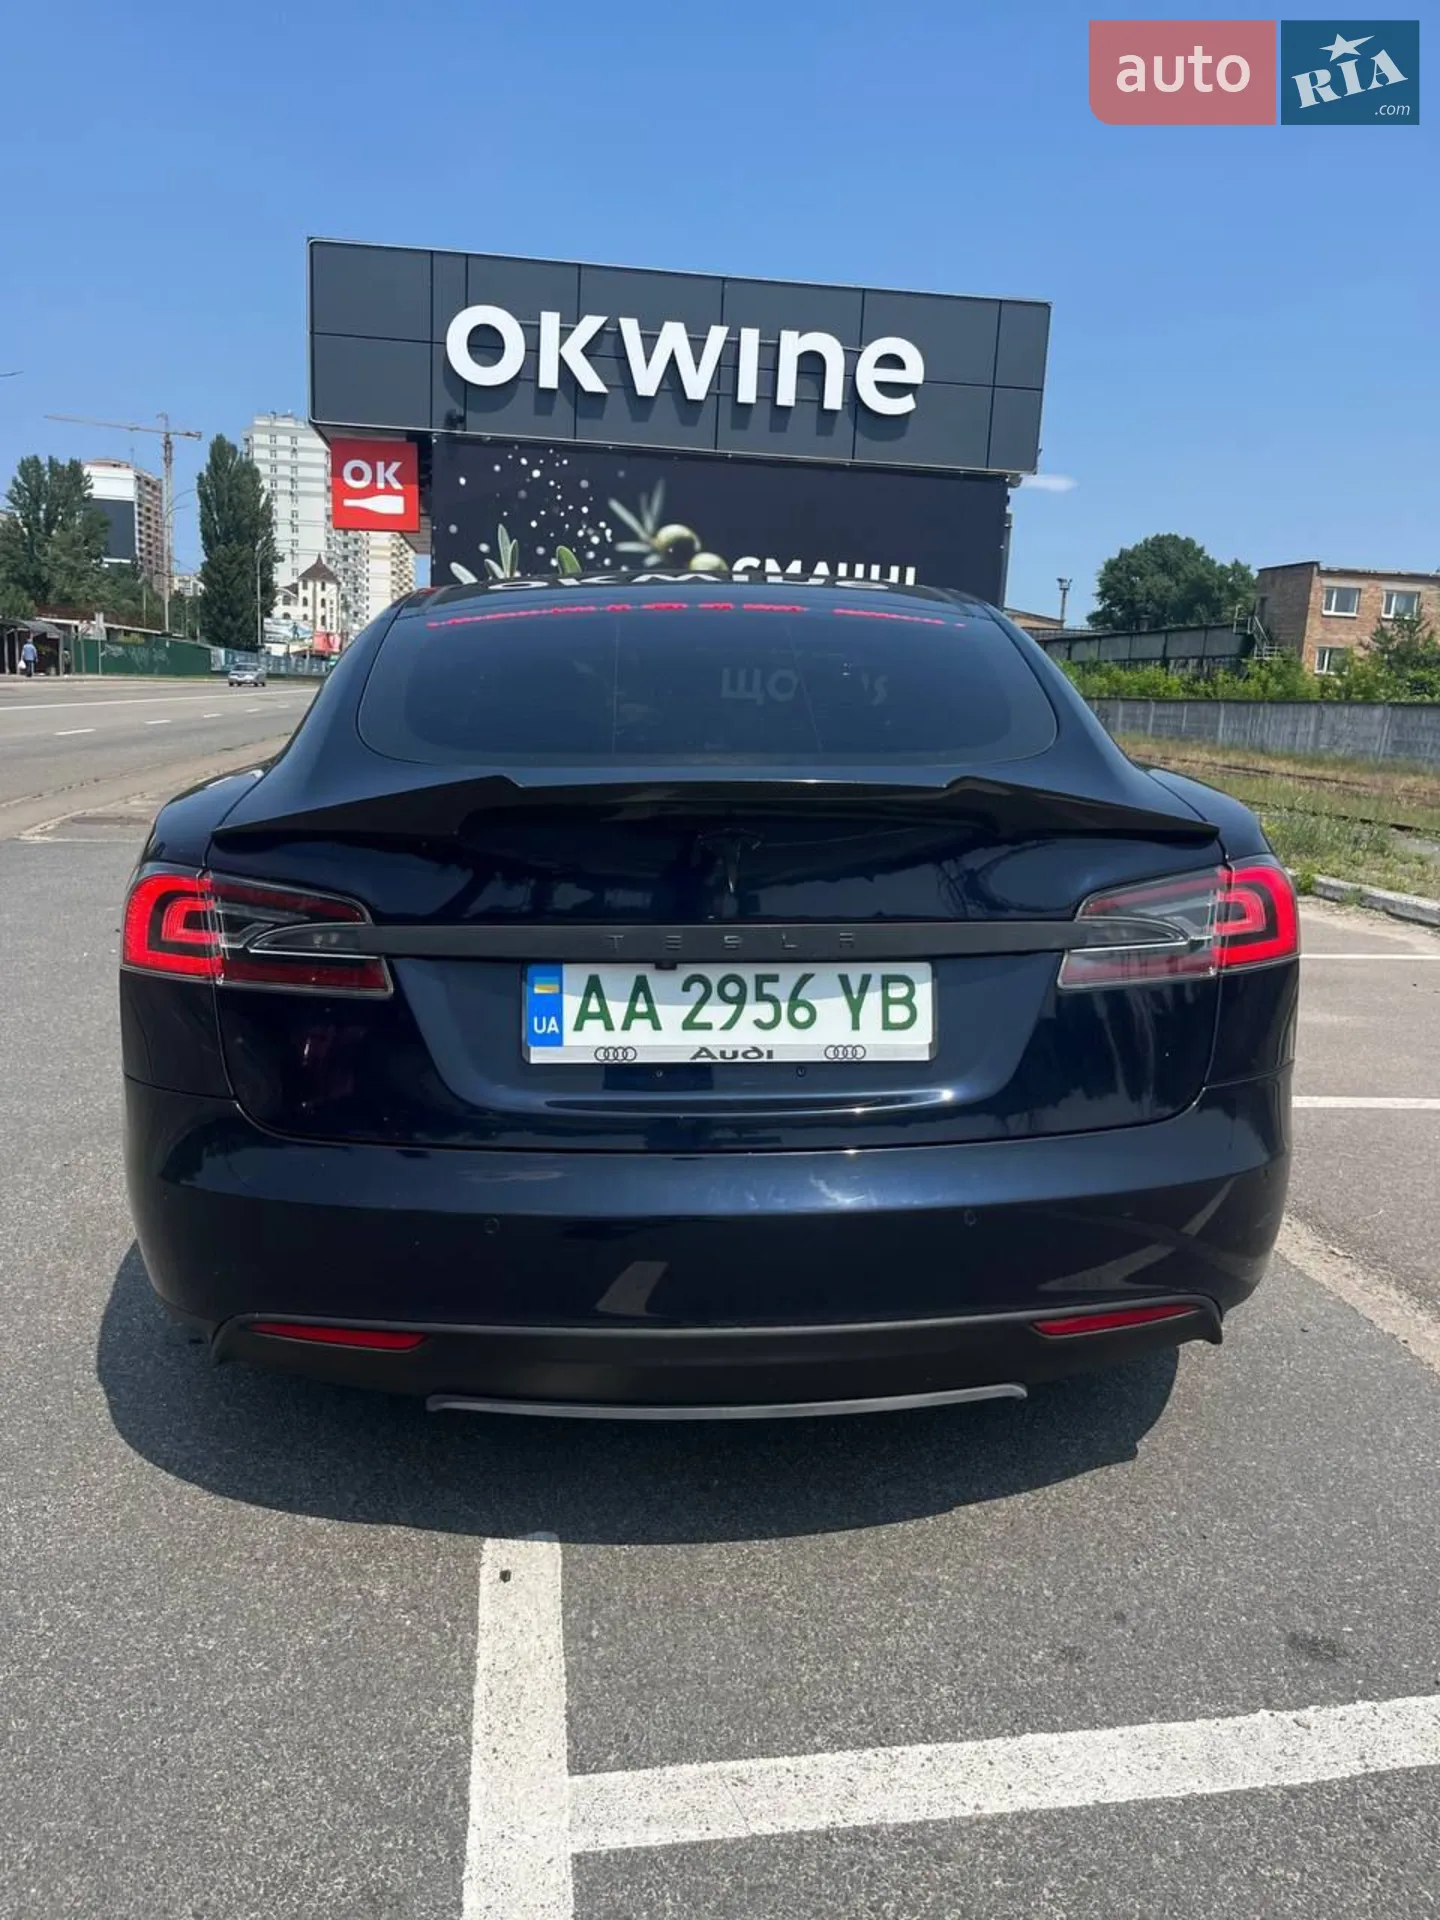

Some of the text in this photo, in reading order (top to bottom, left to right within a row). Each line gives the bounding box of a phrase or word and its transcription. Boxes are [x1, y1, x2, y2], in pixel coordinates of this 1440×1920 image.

[343, 459, 404, 490] OK
[608, 932, 856, 950] TESLA
[573, 973, 918, 1032] AA 2956 YB
[533, 1017, 559, 1035] UA
[689, 1046, 775, 1061] Audi
